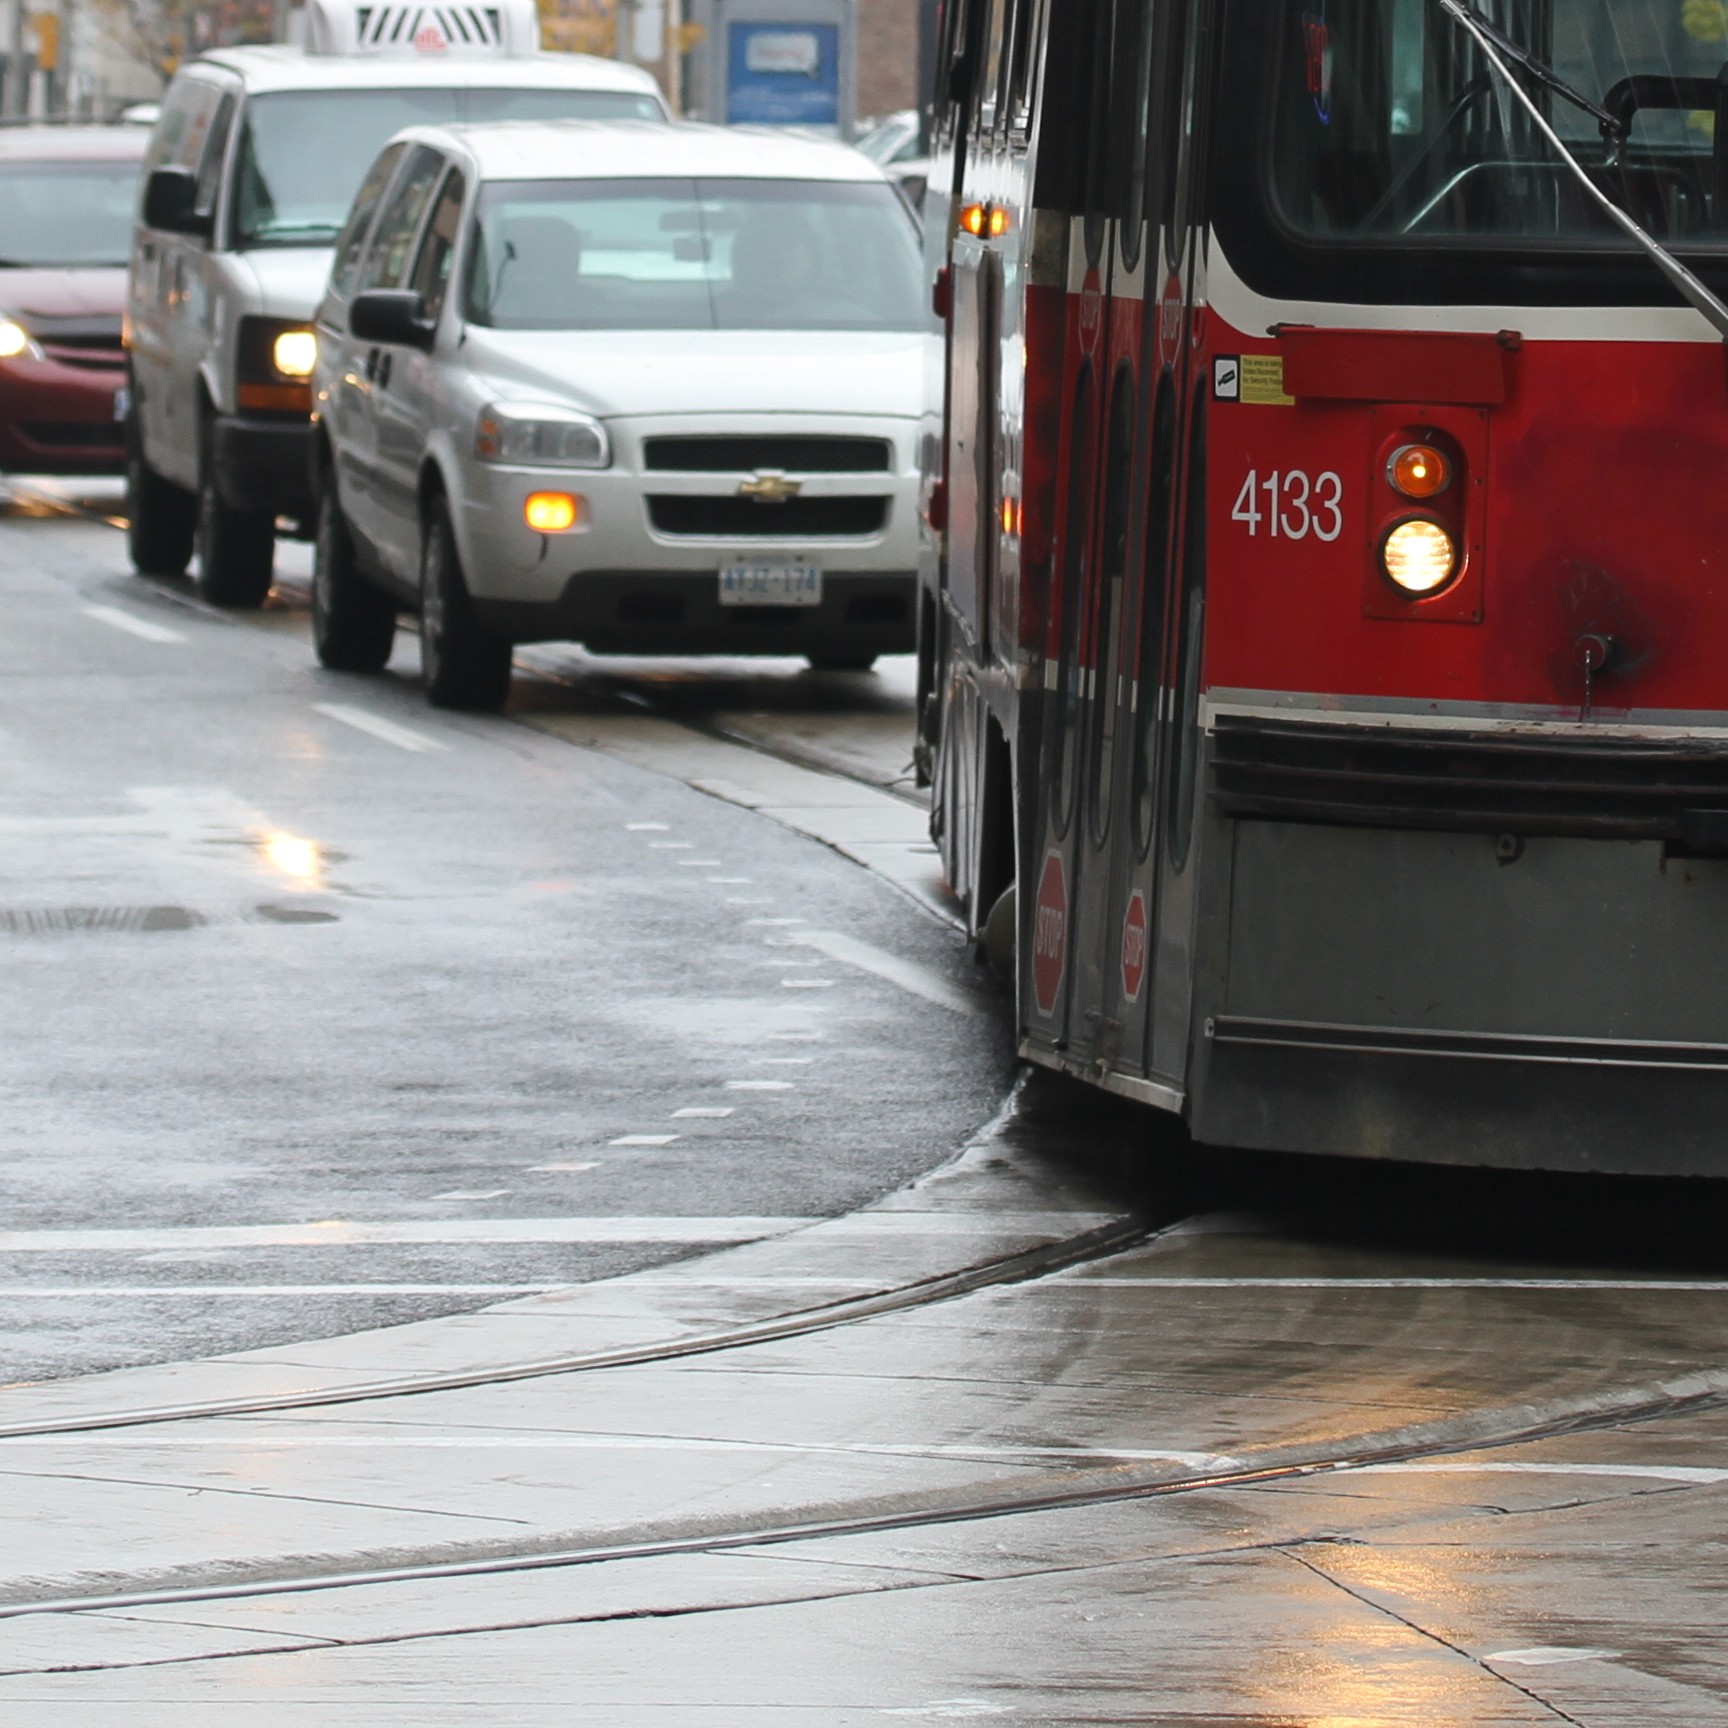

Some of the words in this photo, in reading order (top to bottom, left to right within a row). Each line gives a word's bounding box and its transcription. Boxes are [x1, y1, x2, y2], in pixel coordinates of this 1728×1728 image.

[1231, 469, 1343, 542] 4133
[1037, 904, 1064, 960] STOP
[1125, 923, 1144, 968] STOP
